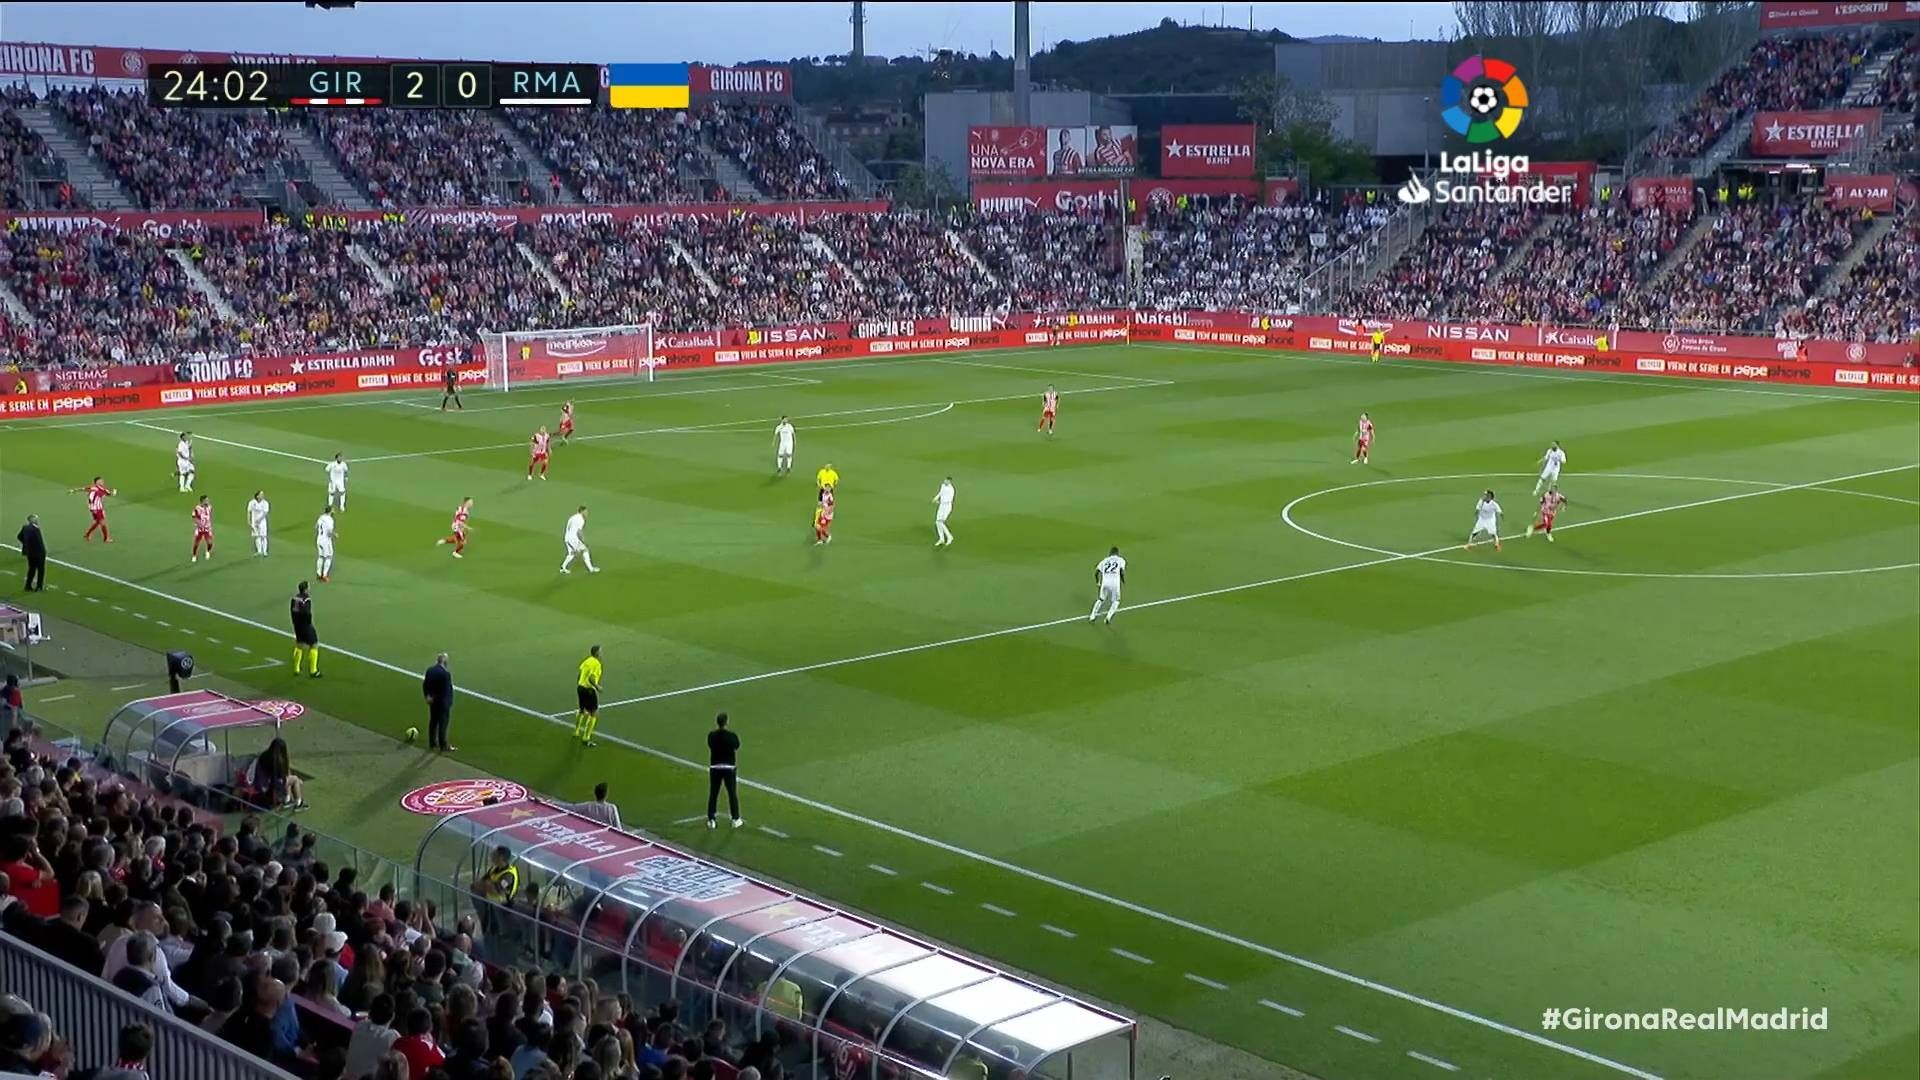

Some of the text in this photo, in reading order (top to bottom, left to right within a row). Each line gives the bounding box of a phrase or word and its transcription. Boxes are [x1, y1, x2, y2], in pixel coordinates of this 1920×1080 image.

[0, 45, 95, 74] IRONA FC
[710, 70, 783, 91] GIRONA FC
[1787, 124, 1865, 140] ESTRELLA
[971, 144, 998, 156] UNA
[1186, 145, 1251, 157] ESTRELLA
[971, 156, 1035, 168] NOVA ERA
[1427, 325, 1509, 342] NISSAN
[307, 354, 396, 370] ESTRELLA DAMM
[55, 368, 108, 380] SISTEMAS
[175, 360, 231, 383] RONA
[1103, 561, 1118, 574] 22
